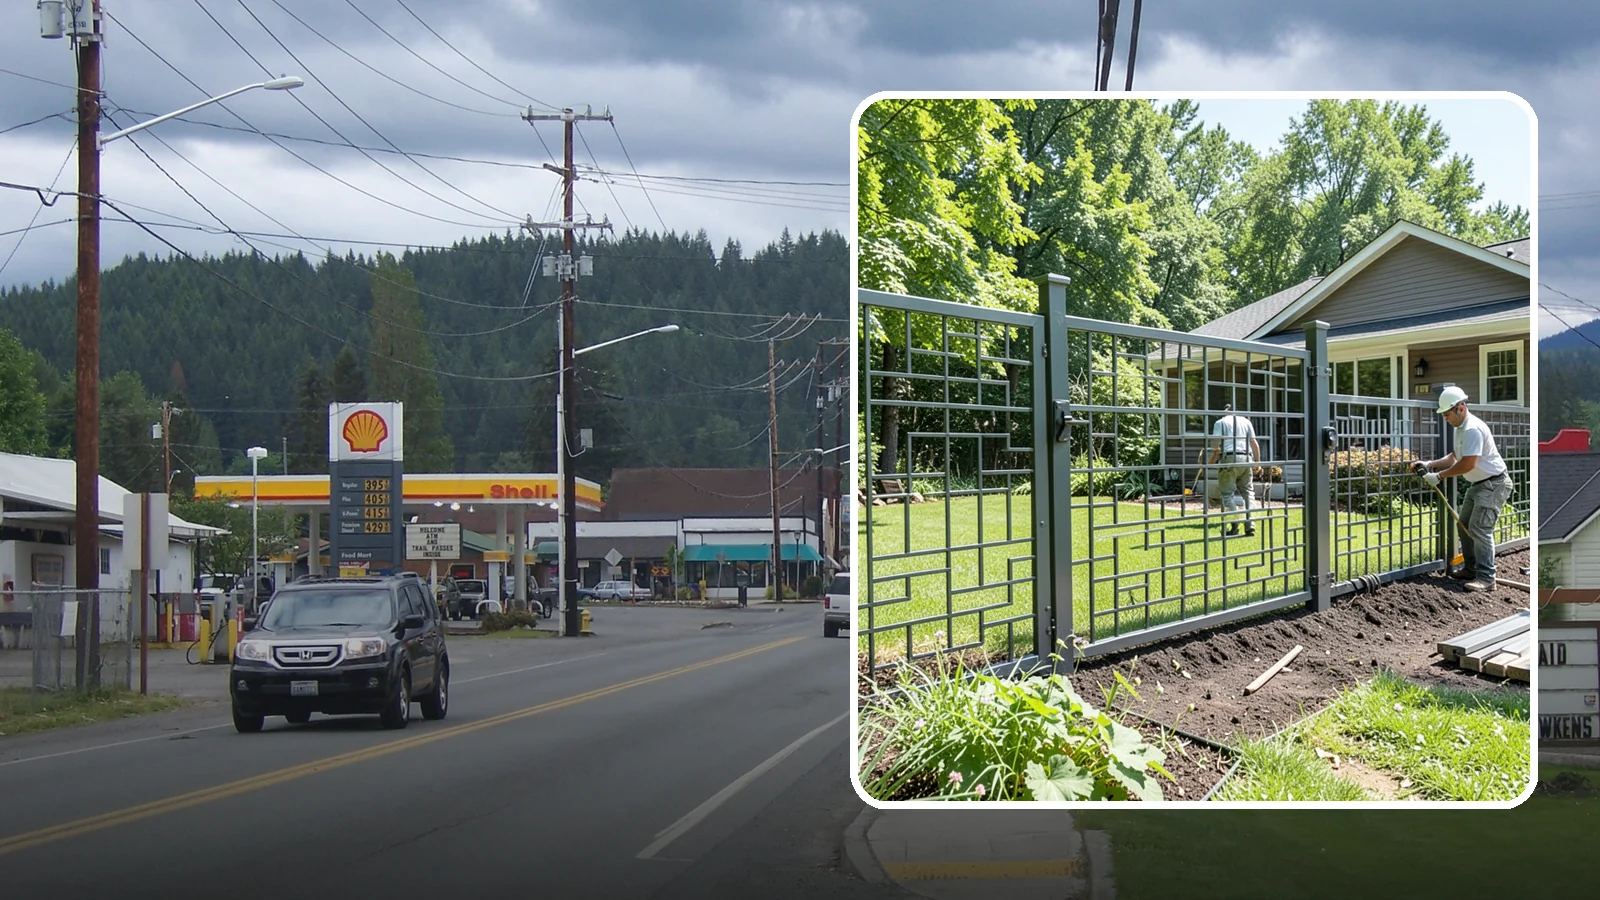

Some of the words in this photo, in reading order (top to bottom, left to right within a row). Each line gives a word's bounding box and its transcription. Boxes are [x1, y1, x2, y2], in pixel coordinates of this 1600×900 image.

[366, 480, 383, 490] 395
[490, 484, 547, 498] Shell
[366, 494, 383, 504] 405
[366, 508, 383, 518] 415
[366, 522, 383, 532] 429
[1539, 643, 1567, 666] AID
